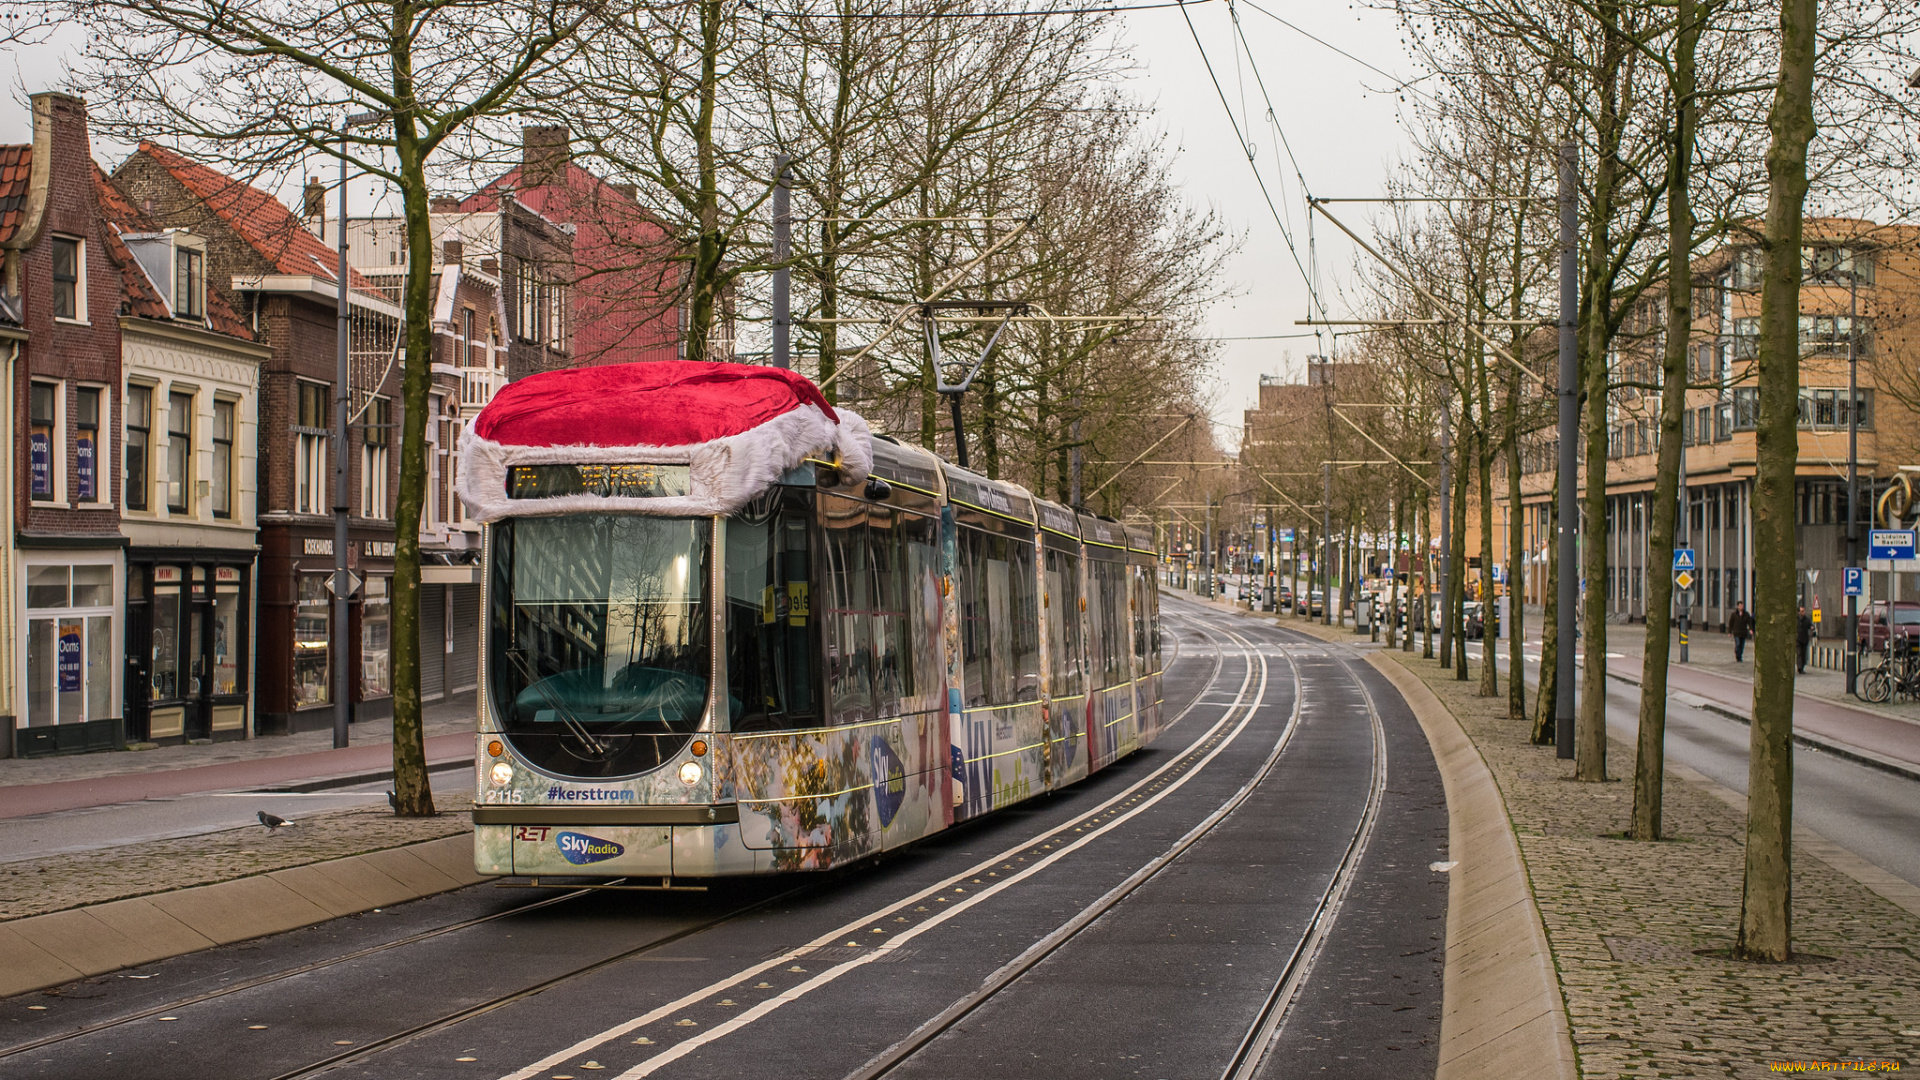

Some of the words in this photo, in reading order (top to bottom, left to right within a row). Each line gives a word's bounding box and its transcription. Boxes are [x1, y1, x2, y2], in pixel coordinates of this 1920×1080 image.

[1848, 570, 1859, 585] P
[486, 789, 523, 803] 2115
[547, 786, 634, 801] #kersttram
[516, 826, 551, 842] RET
[561, 835, 589, 854] Sky
[587, 844, 618, 855] Radio
